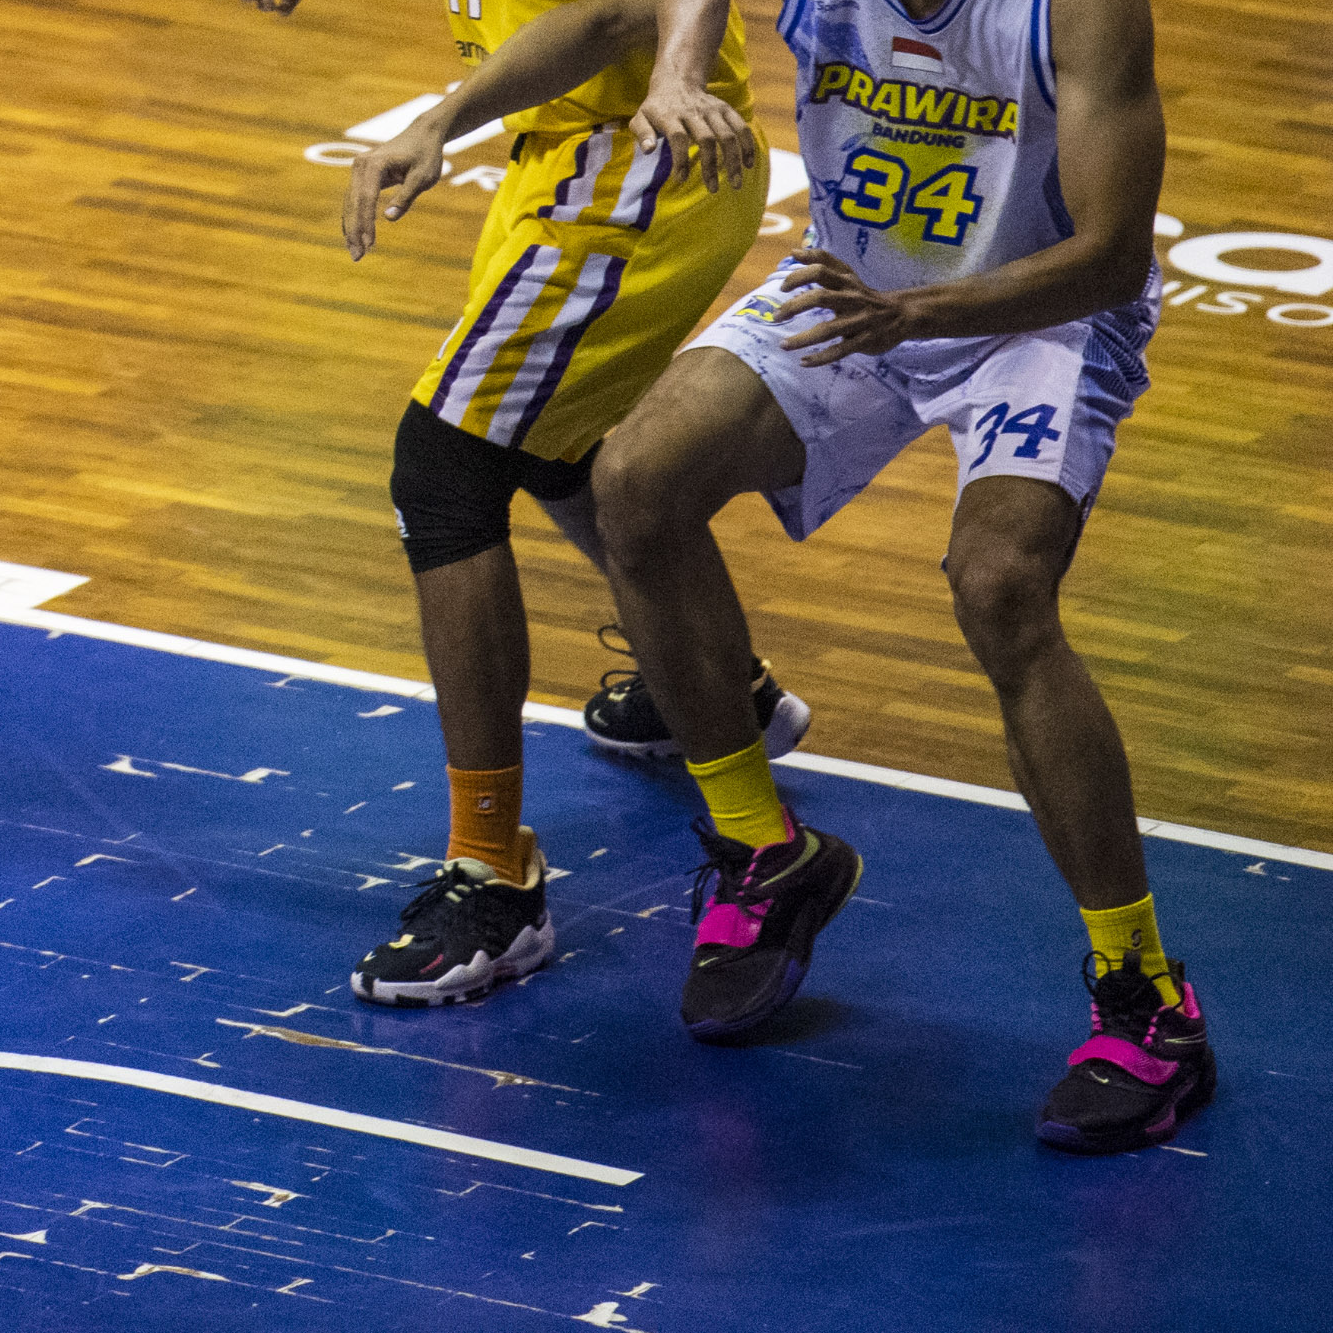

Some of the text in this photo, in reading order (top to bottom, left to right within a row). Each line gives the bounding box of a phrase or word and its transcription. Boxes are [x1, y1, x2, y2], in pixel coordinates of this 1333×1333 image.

[810, 60, 1020, 141] PRAWIRA
[872, 121, 966, 149] BANDUNG
[833, 145, 985, 247] 34
[968, 401, 1062, 472] 34
